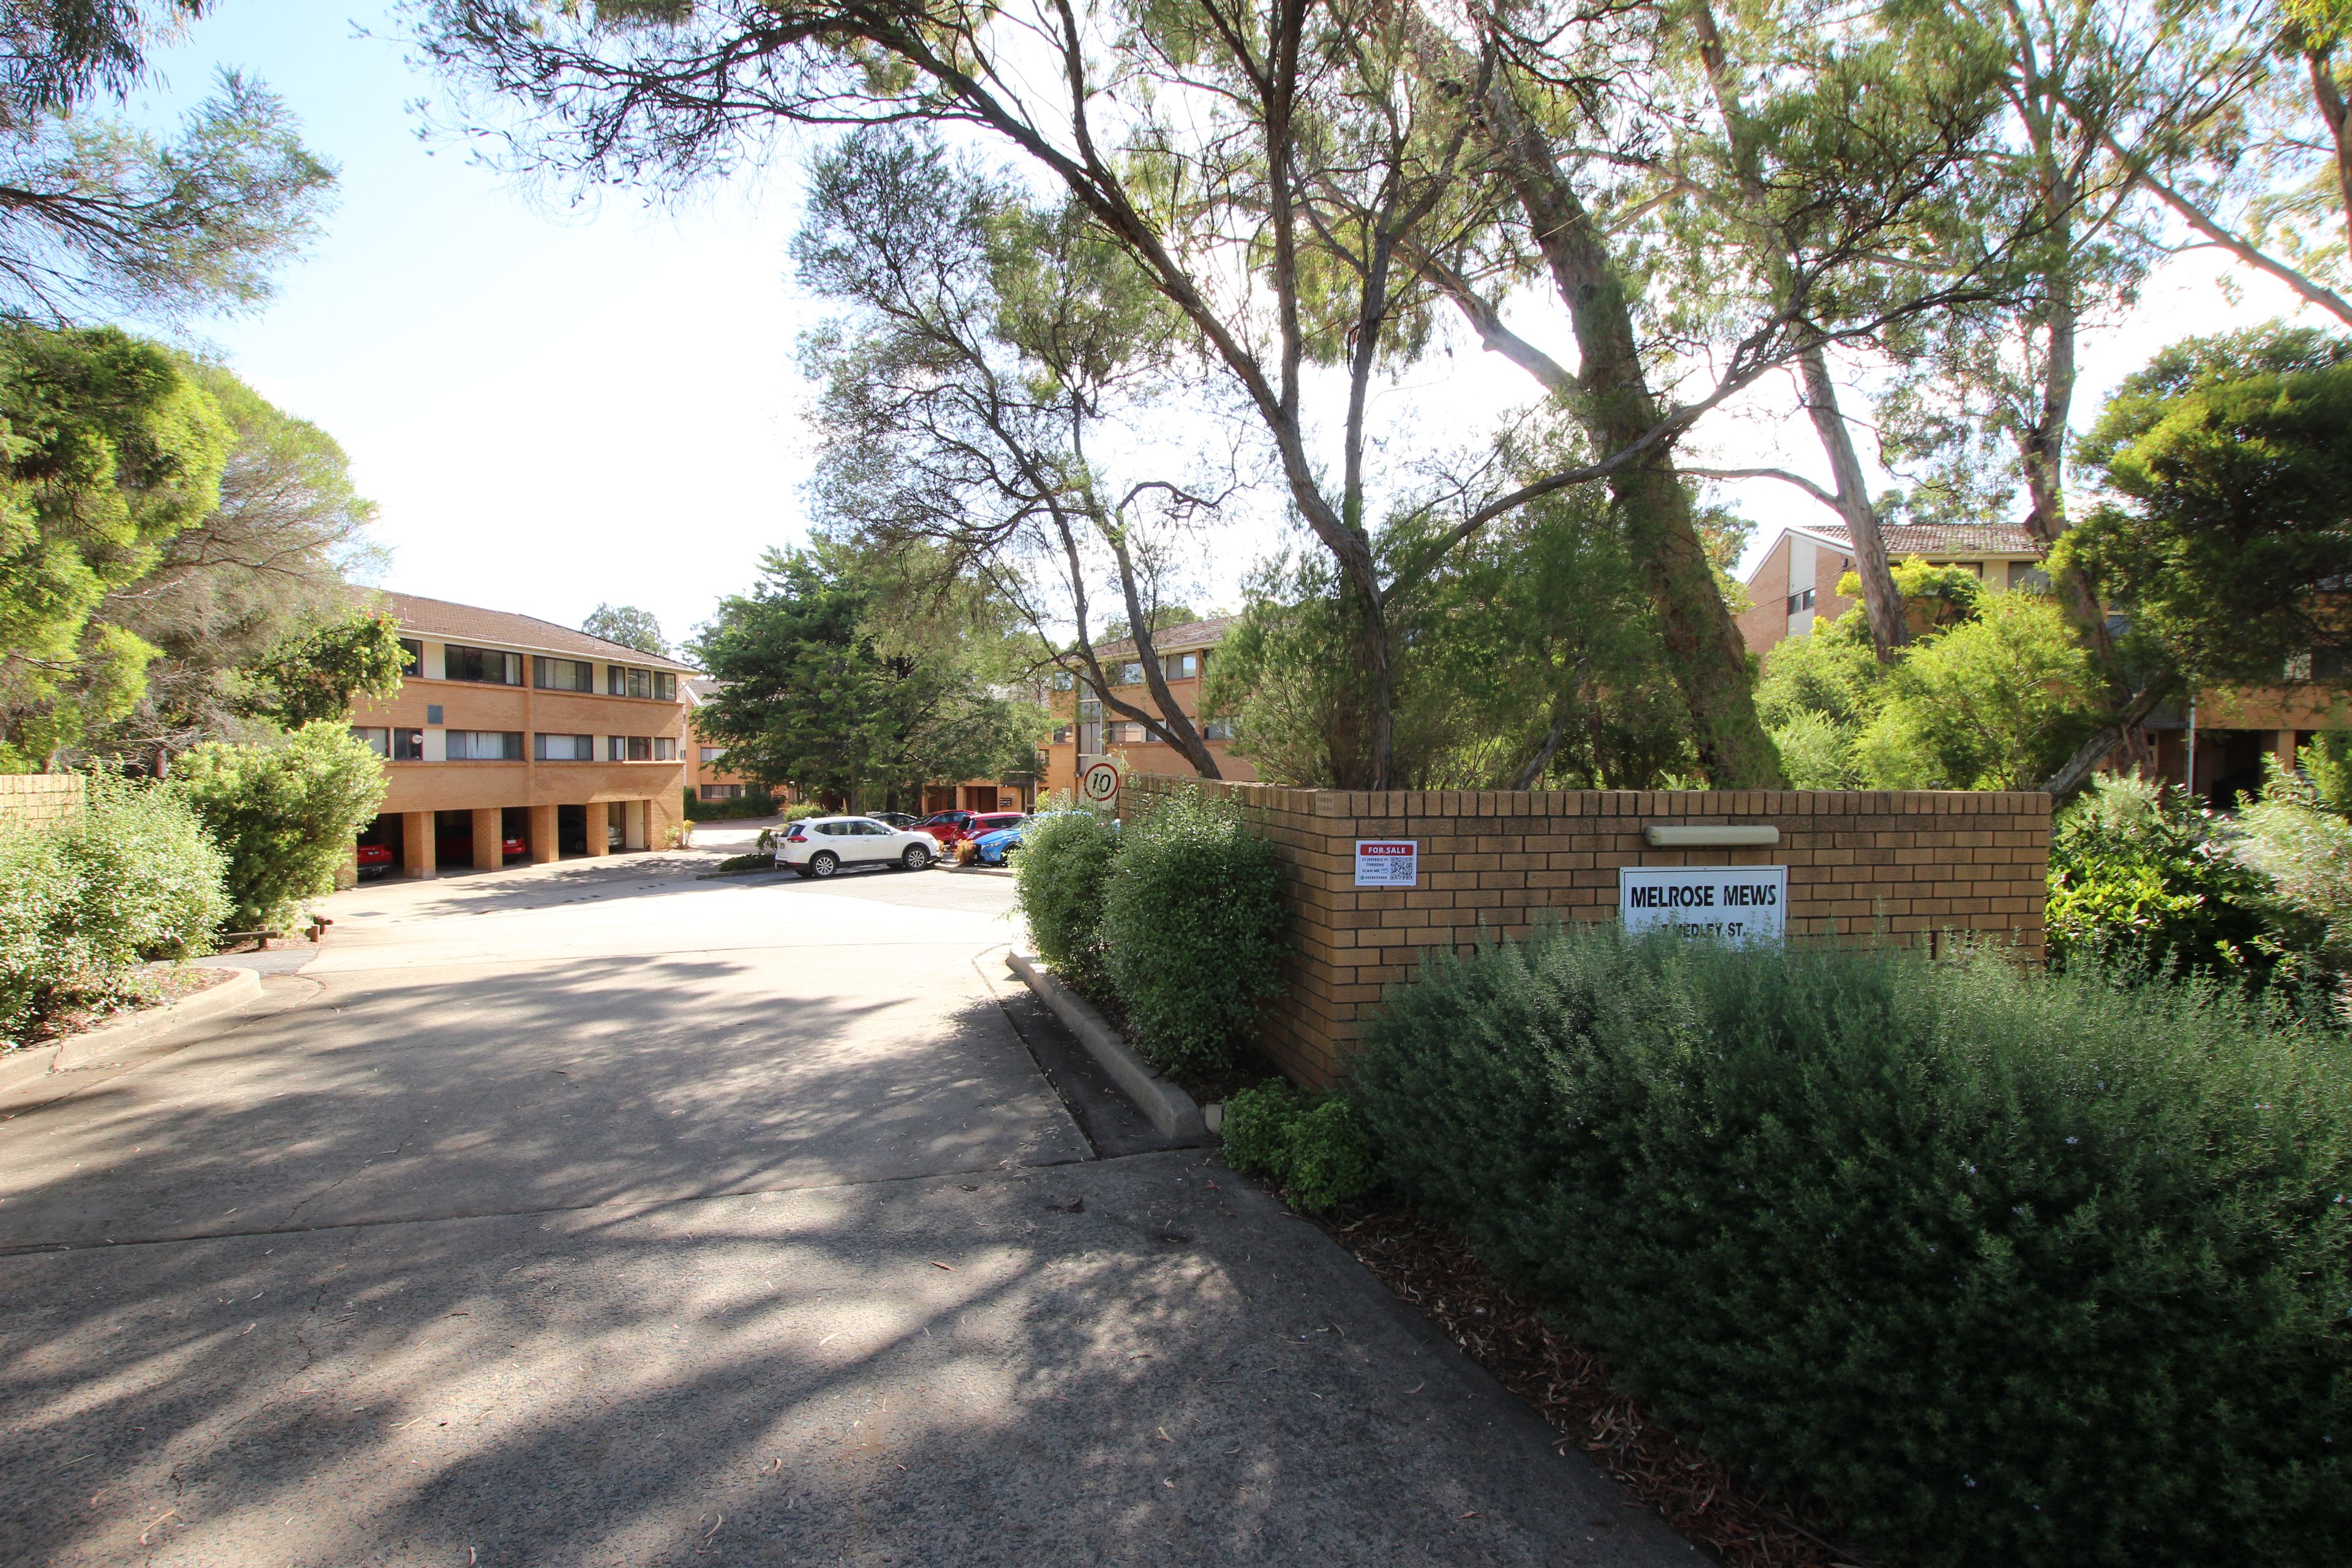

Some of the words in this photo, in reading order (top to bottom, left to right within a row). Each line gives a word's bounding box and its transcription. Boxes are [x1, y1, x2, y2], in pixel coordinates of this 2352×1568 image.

[1092, 772, 1111, 793] 10
[1630, 885, 1714, 908] MELROSE
[1723, 884, 1776, 907] MEWS
